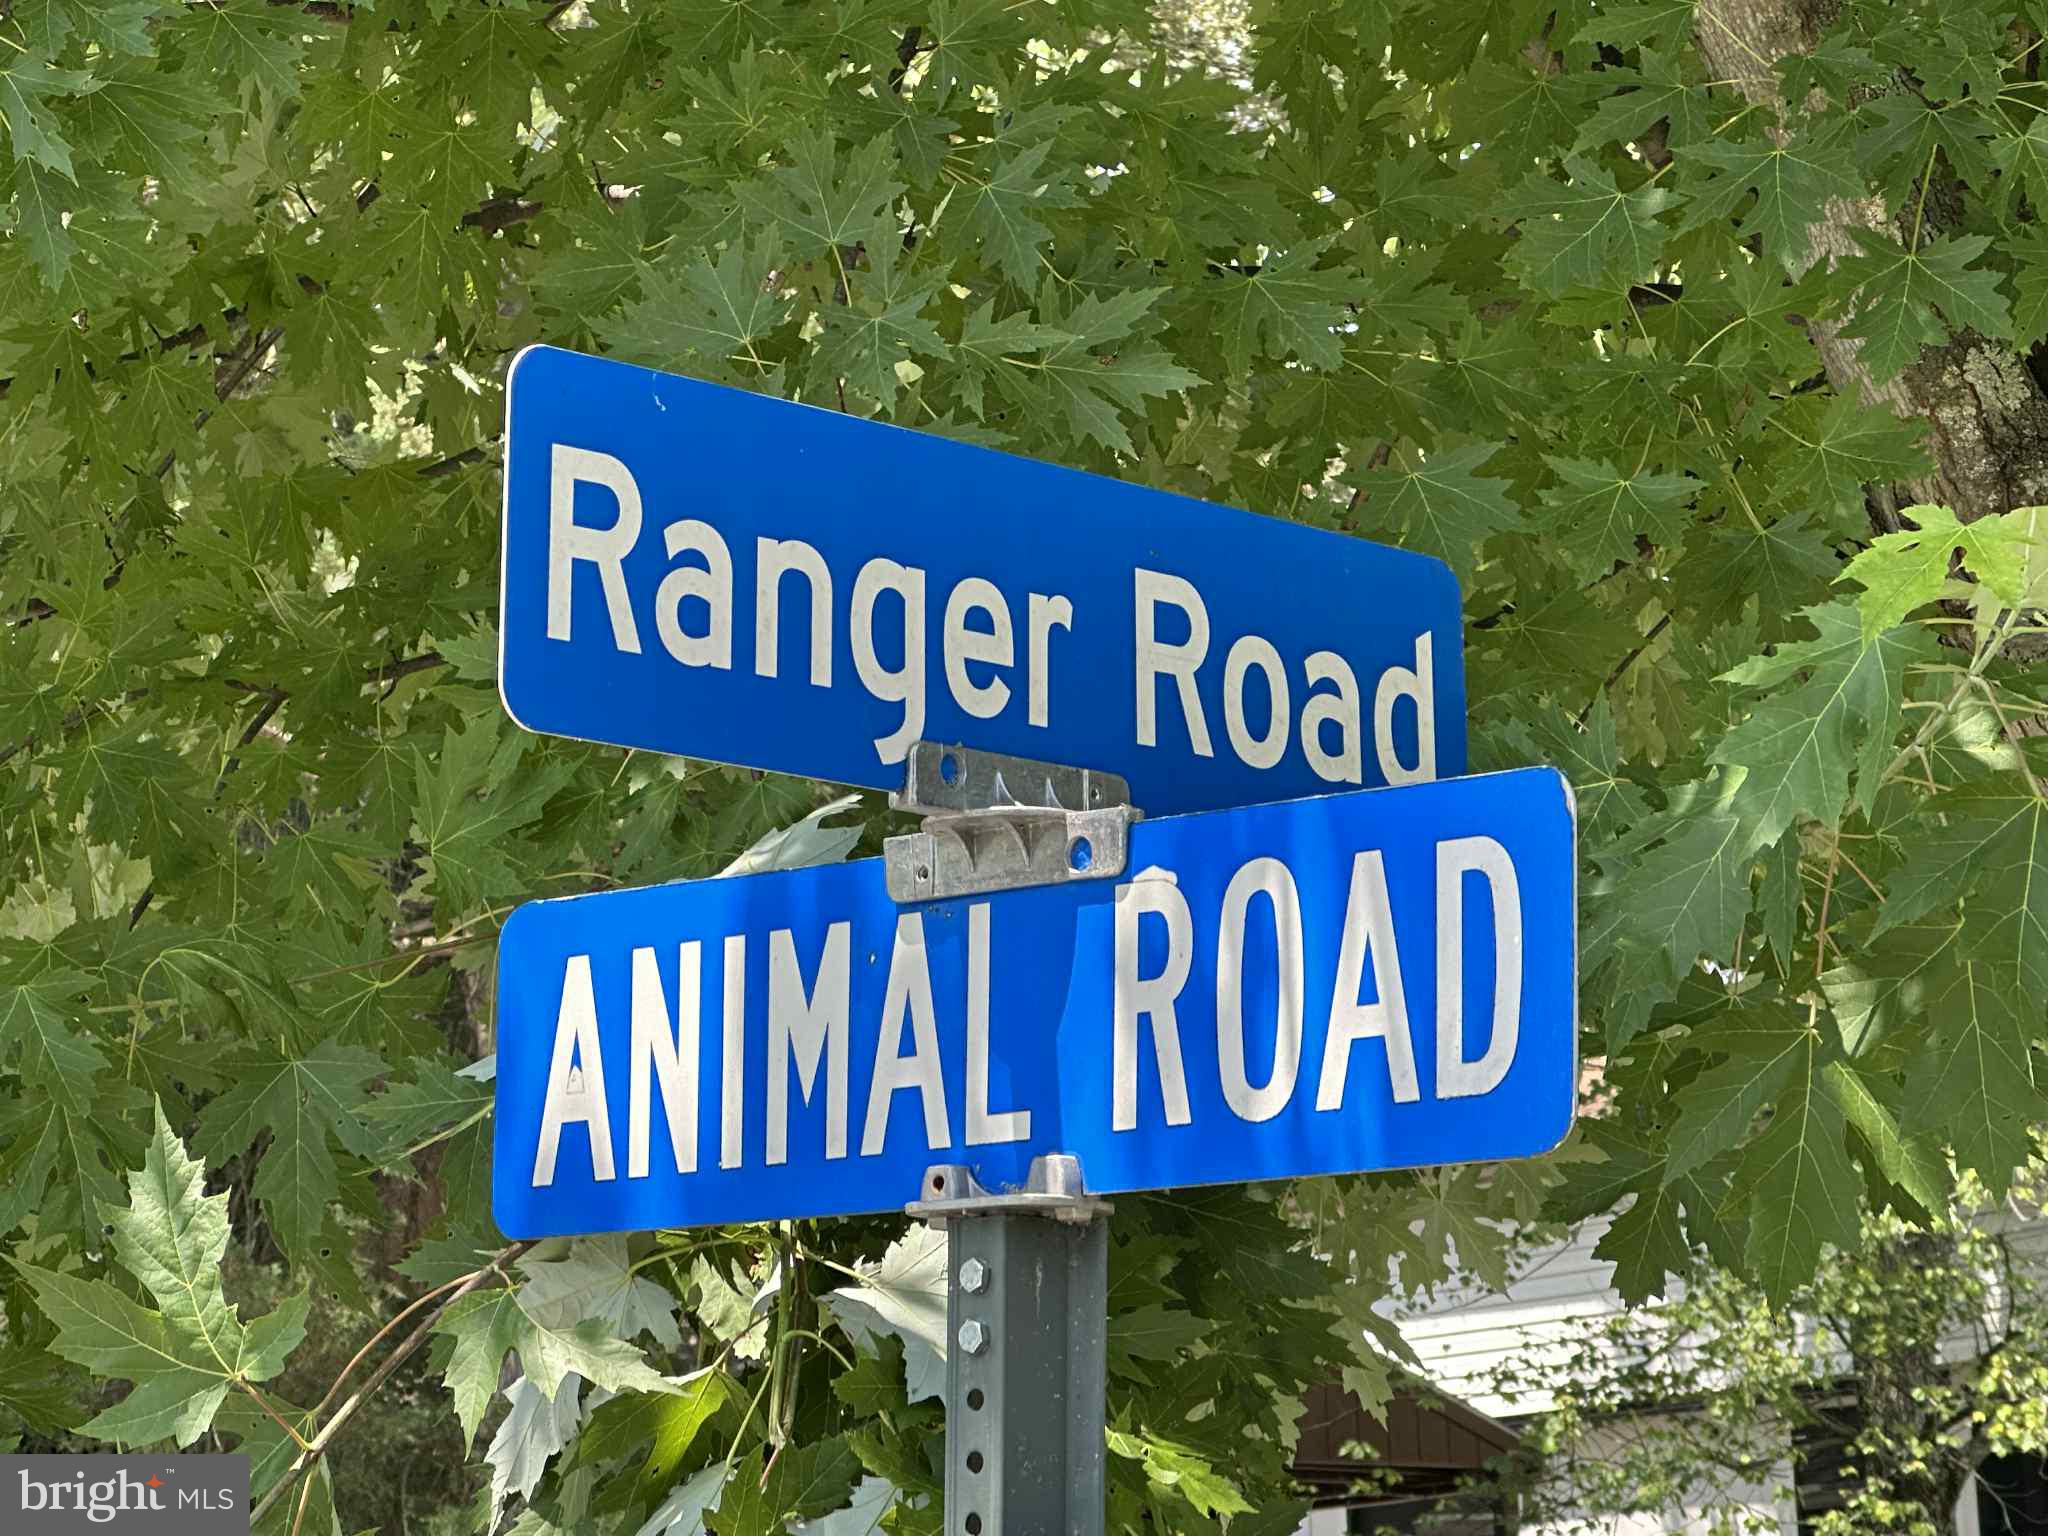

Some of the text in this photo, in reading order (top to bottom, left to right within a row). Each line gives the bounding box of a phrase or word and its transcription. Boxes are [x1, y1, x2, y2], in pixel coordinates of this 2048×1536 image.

[546, 443, 1438, 788] Ranger Road
[532, 835, 1523, 1187] ANIMAL ROAD
